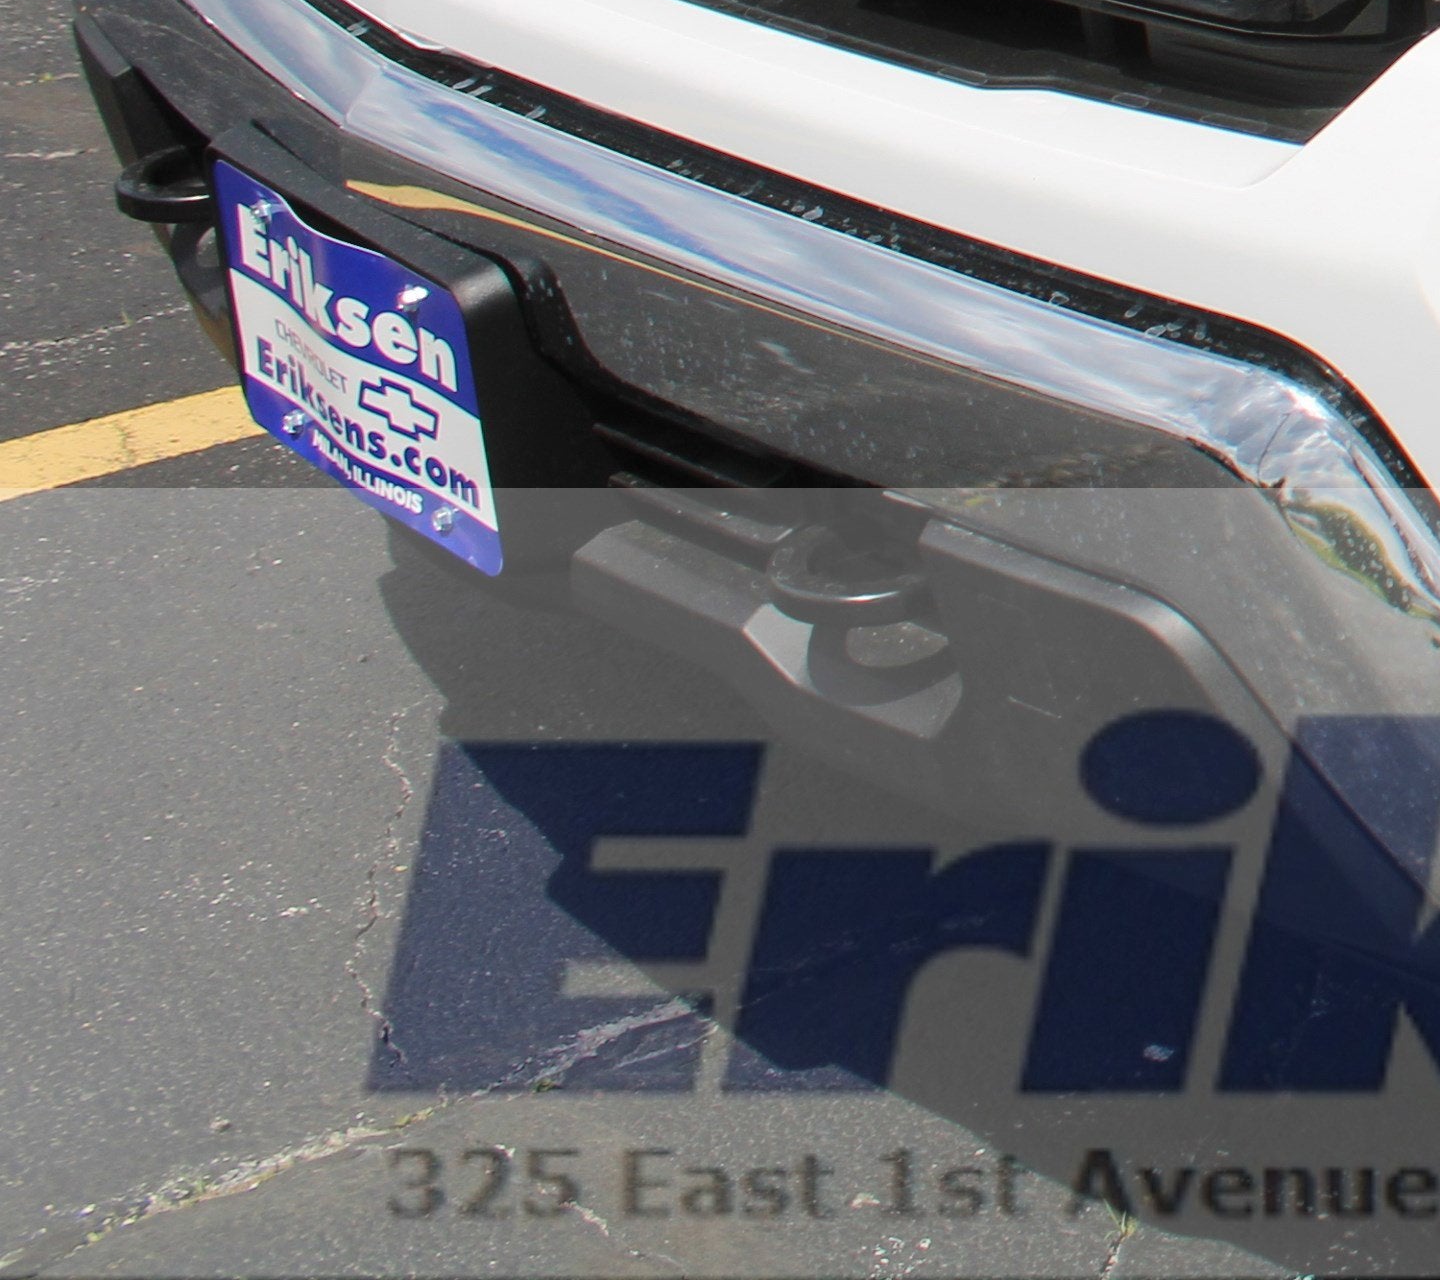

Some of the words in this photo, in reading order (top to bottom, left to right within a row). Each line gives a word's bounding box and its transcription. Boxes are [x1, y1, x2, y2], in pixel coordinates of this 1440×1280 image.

[237, 203, 458, 393] Eriksen
[275, 319, 348, 393] CHEVROLET
[256, 336, 481, 509] Eriksens.com
[312, 428, 352, 481] MILAN,
[352, 469, 424, 515] ILLINOIS
